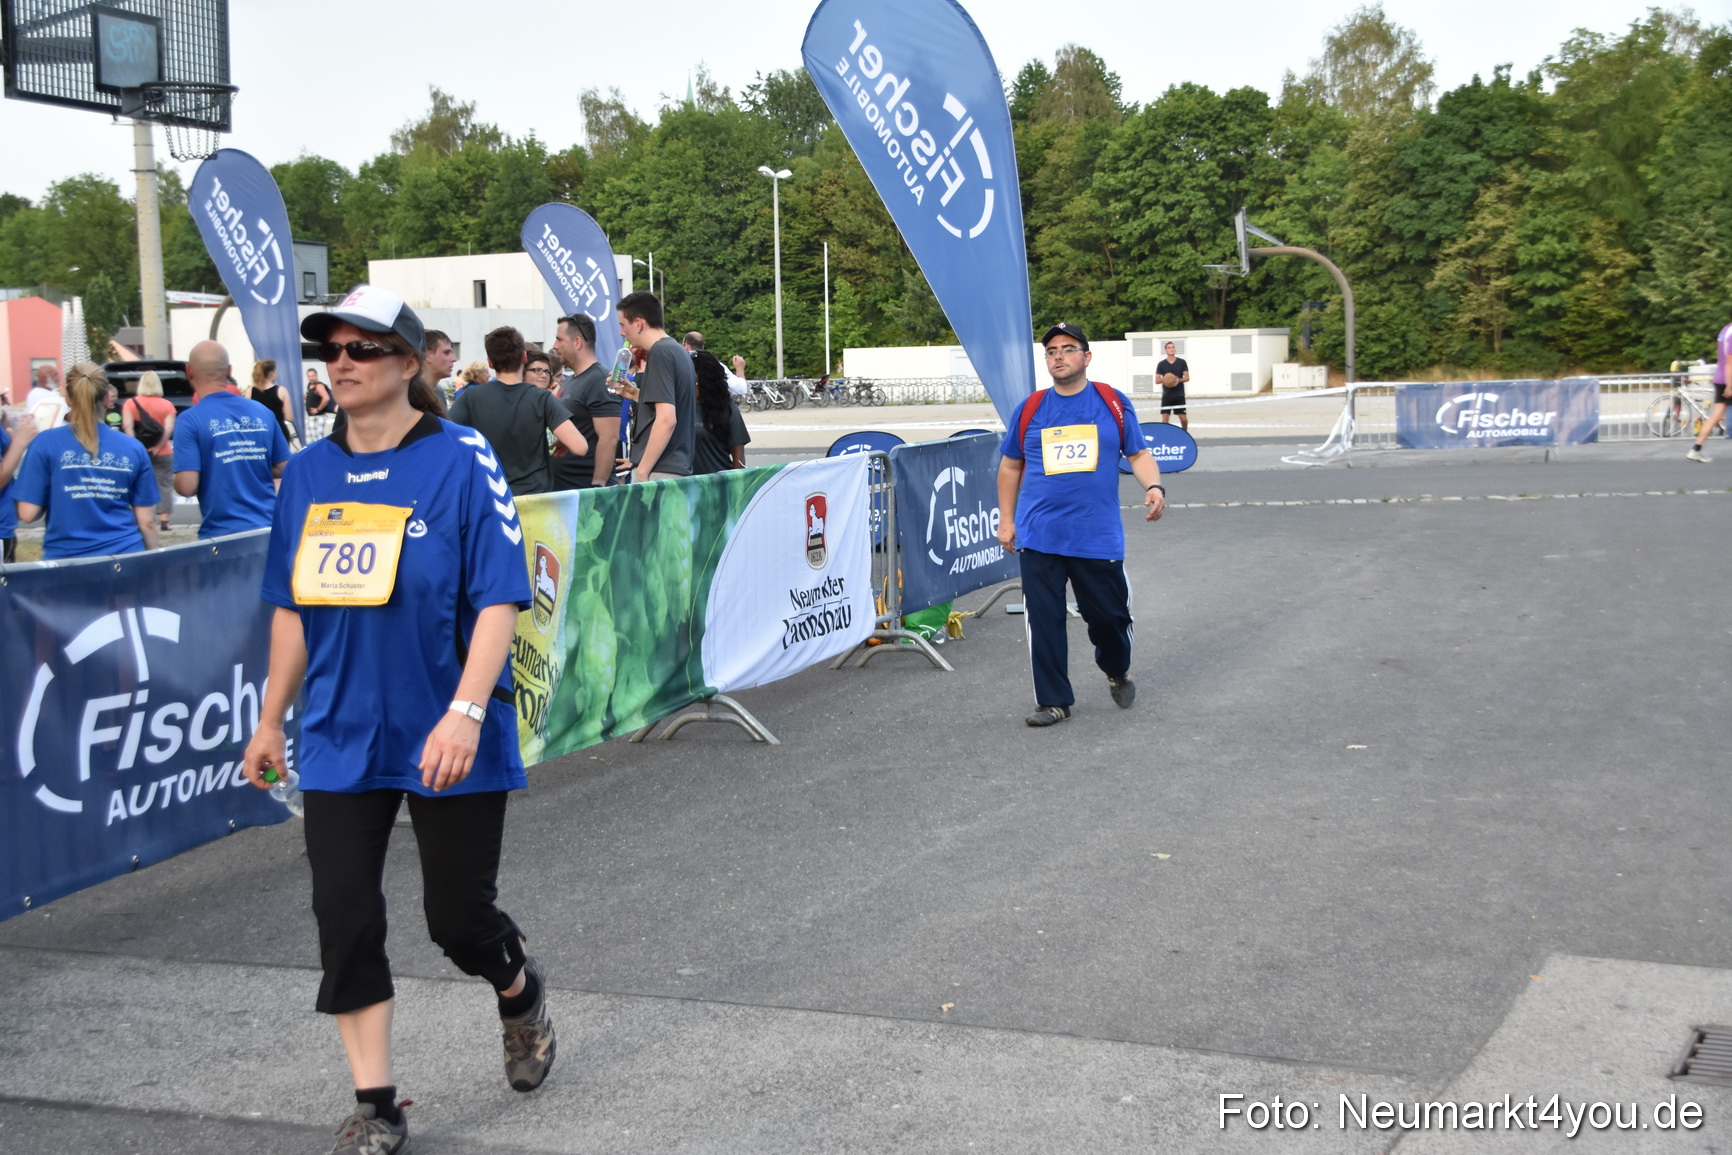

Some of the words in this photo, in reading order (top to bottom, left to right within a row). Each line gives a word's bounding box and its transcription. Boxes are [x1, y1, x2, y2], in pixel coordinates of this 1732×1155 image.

[1457, 407, 1557, 429] Fischer
[1466, 428, 1548, 439] AUTOMOBILE
[1053, 443, 1087, 460] 732
[1146, 444, 1187, 456] scher
[347, 468, 390, 484] hummel
[943, 500, 1001, 551] Fische
[318, 542, 377, 575] 780
[810, 550, 823, 564] 1628
[949, 544, 1005, 575] AUTOMOBILE
[338, 582, 366, 590] Schuster
